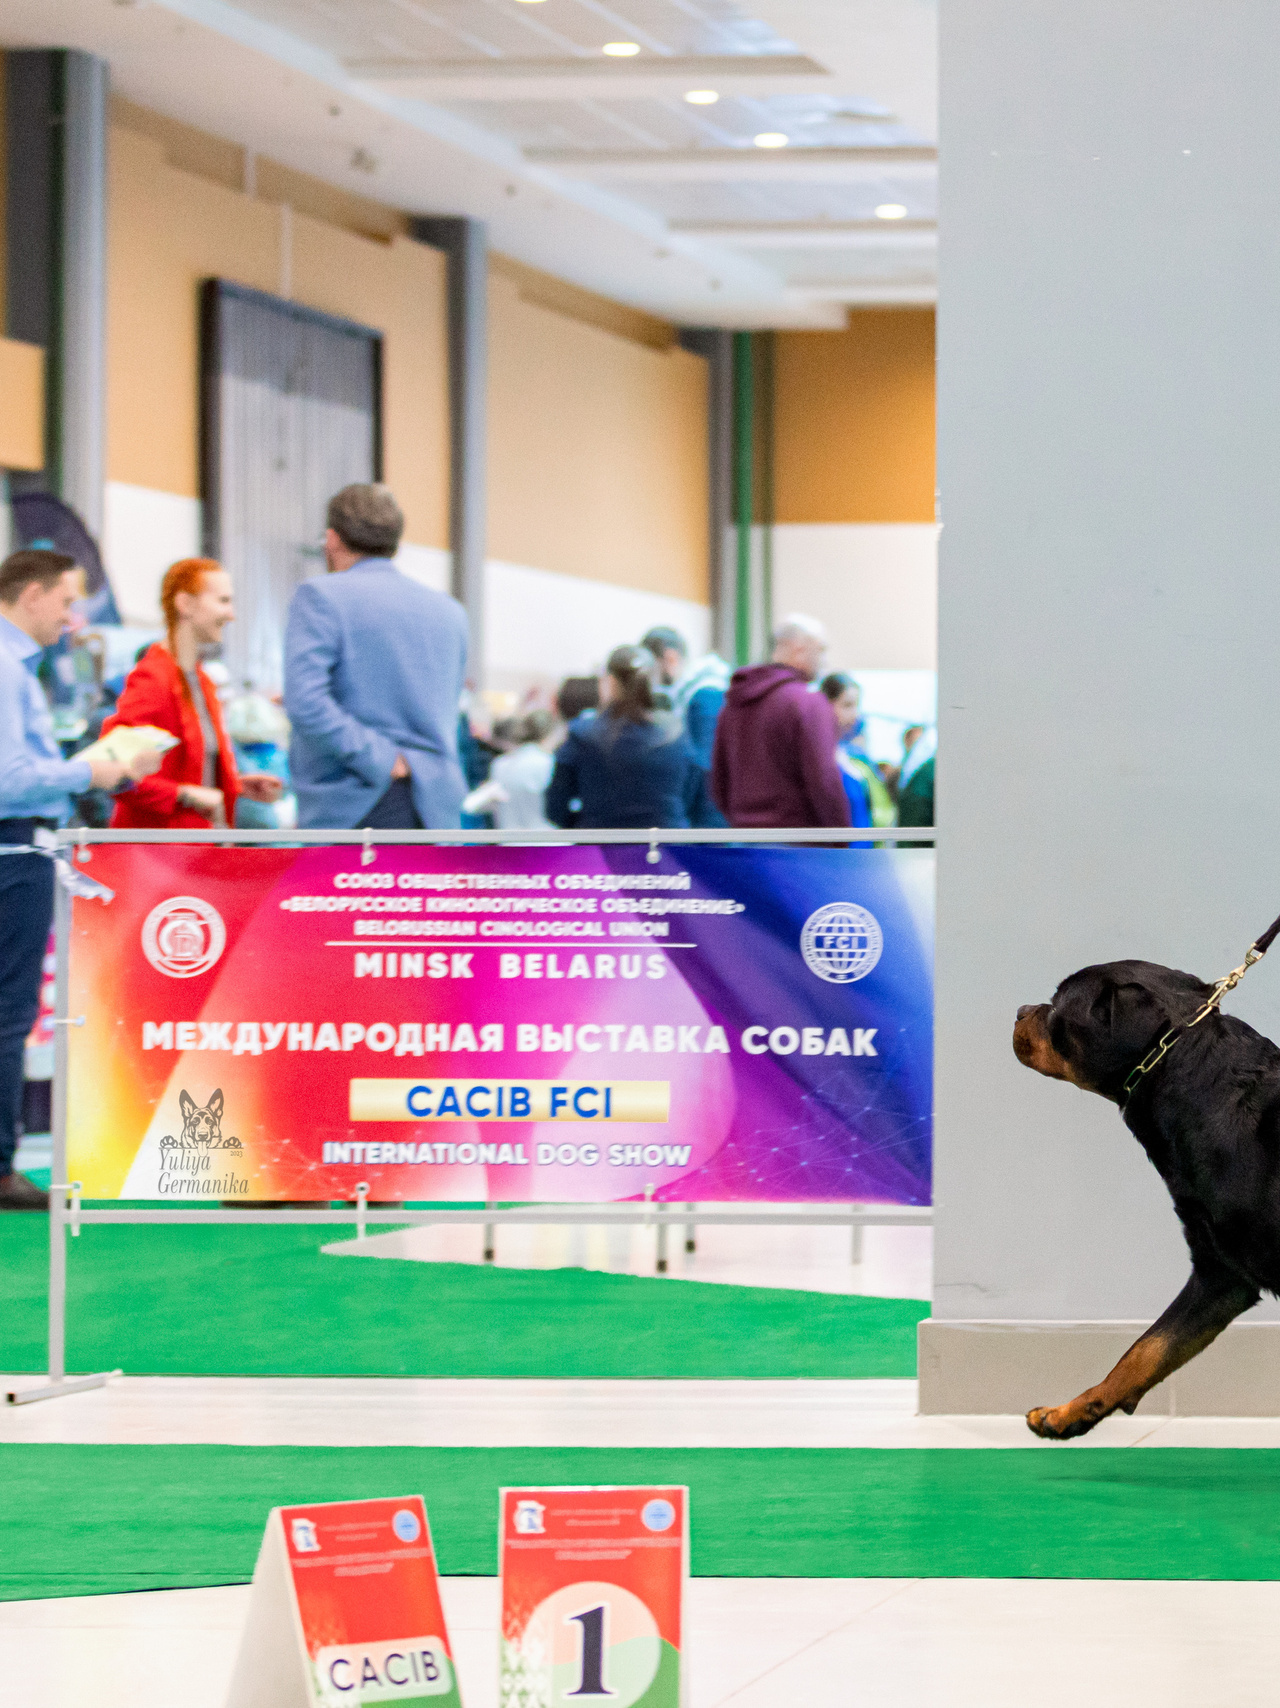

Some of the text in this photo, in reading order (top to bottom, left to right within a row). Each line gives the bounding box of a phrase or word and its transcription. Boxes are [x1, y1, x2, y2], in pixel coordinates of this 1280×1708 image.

[333, 871, 691, 891] СОЮЗ ОБЩЕСТВЕННЫХ ОБЪЕДИНЕНИЙ
[425, 897, 598, 913] КИНОЛОГИЧЕСКОЕ
[354, 920, 669, 937] BELORUSSIAN CINOLOGICAL UNION
[823, 936, 859, 949] FCI
[354, 952, 668, 979] MINSK BELARUS
[142, 1022, 879, 1056] МЕЖДУНАРОДНАЯ ВЫСТАВКА СОБАК
[406, 1085, 612, 1118] CACIB FCI
[322, 1142, 692, 1168] INTERNATIONAL DOG SHOW
[566, 1605, 613, 1696] 1
[328, 1650, 441, 1692] CACIB
